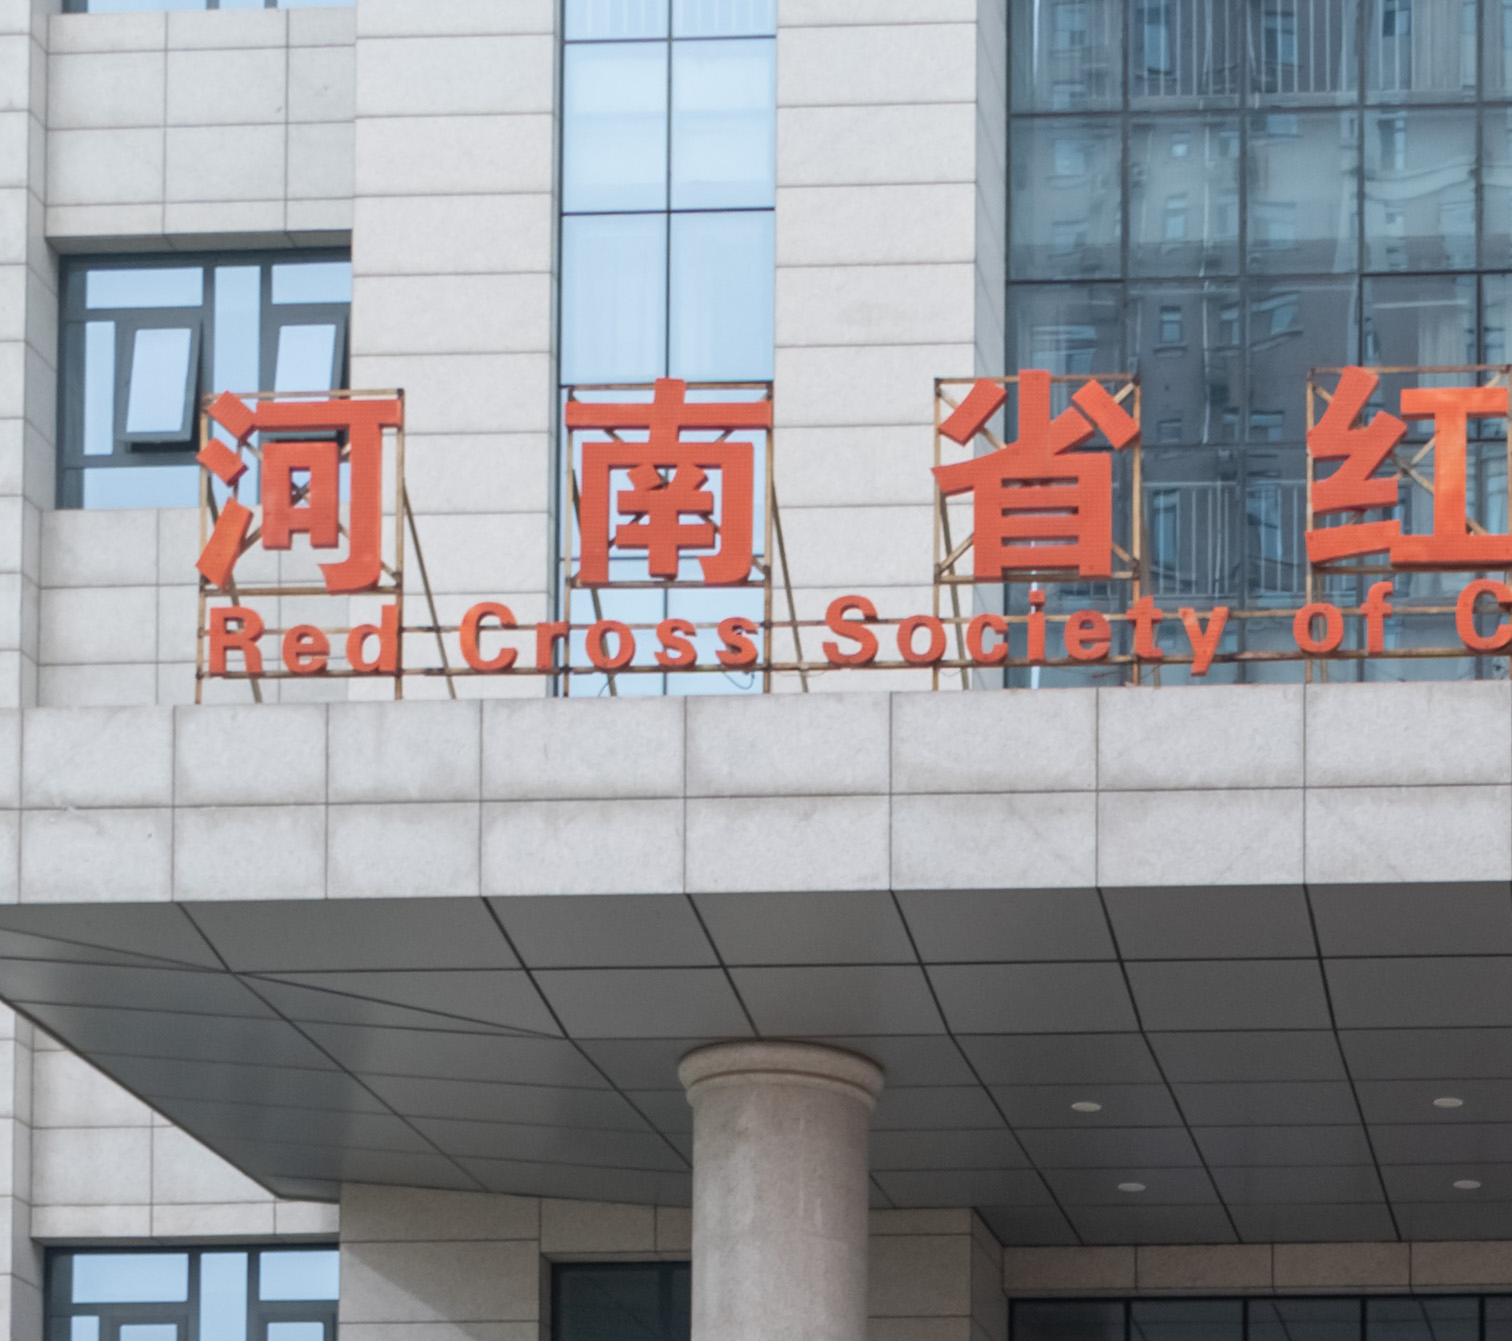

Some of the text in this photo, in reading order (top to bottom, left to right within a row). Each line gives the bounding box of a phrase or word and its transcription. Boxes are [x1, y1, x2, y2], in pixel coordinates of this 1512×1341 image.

[207, 603, 400, 676] Red
[459, 601, 760, 672] Cross
[822, 594, 1229, 676] Society
[1292, 580, 1394, 655] of
